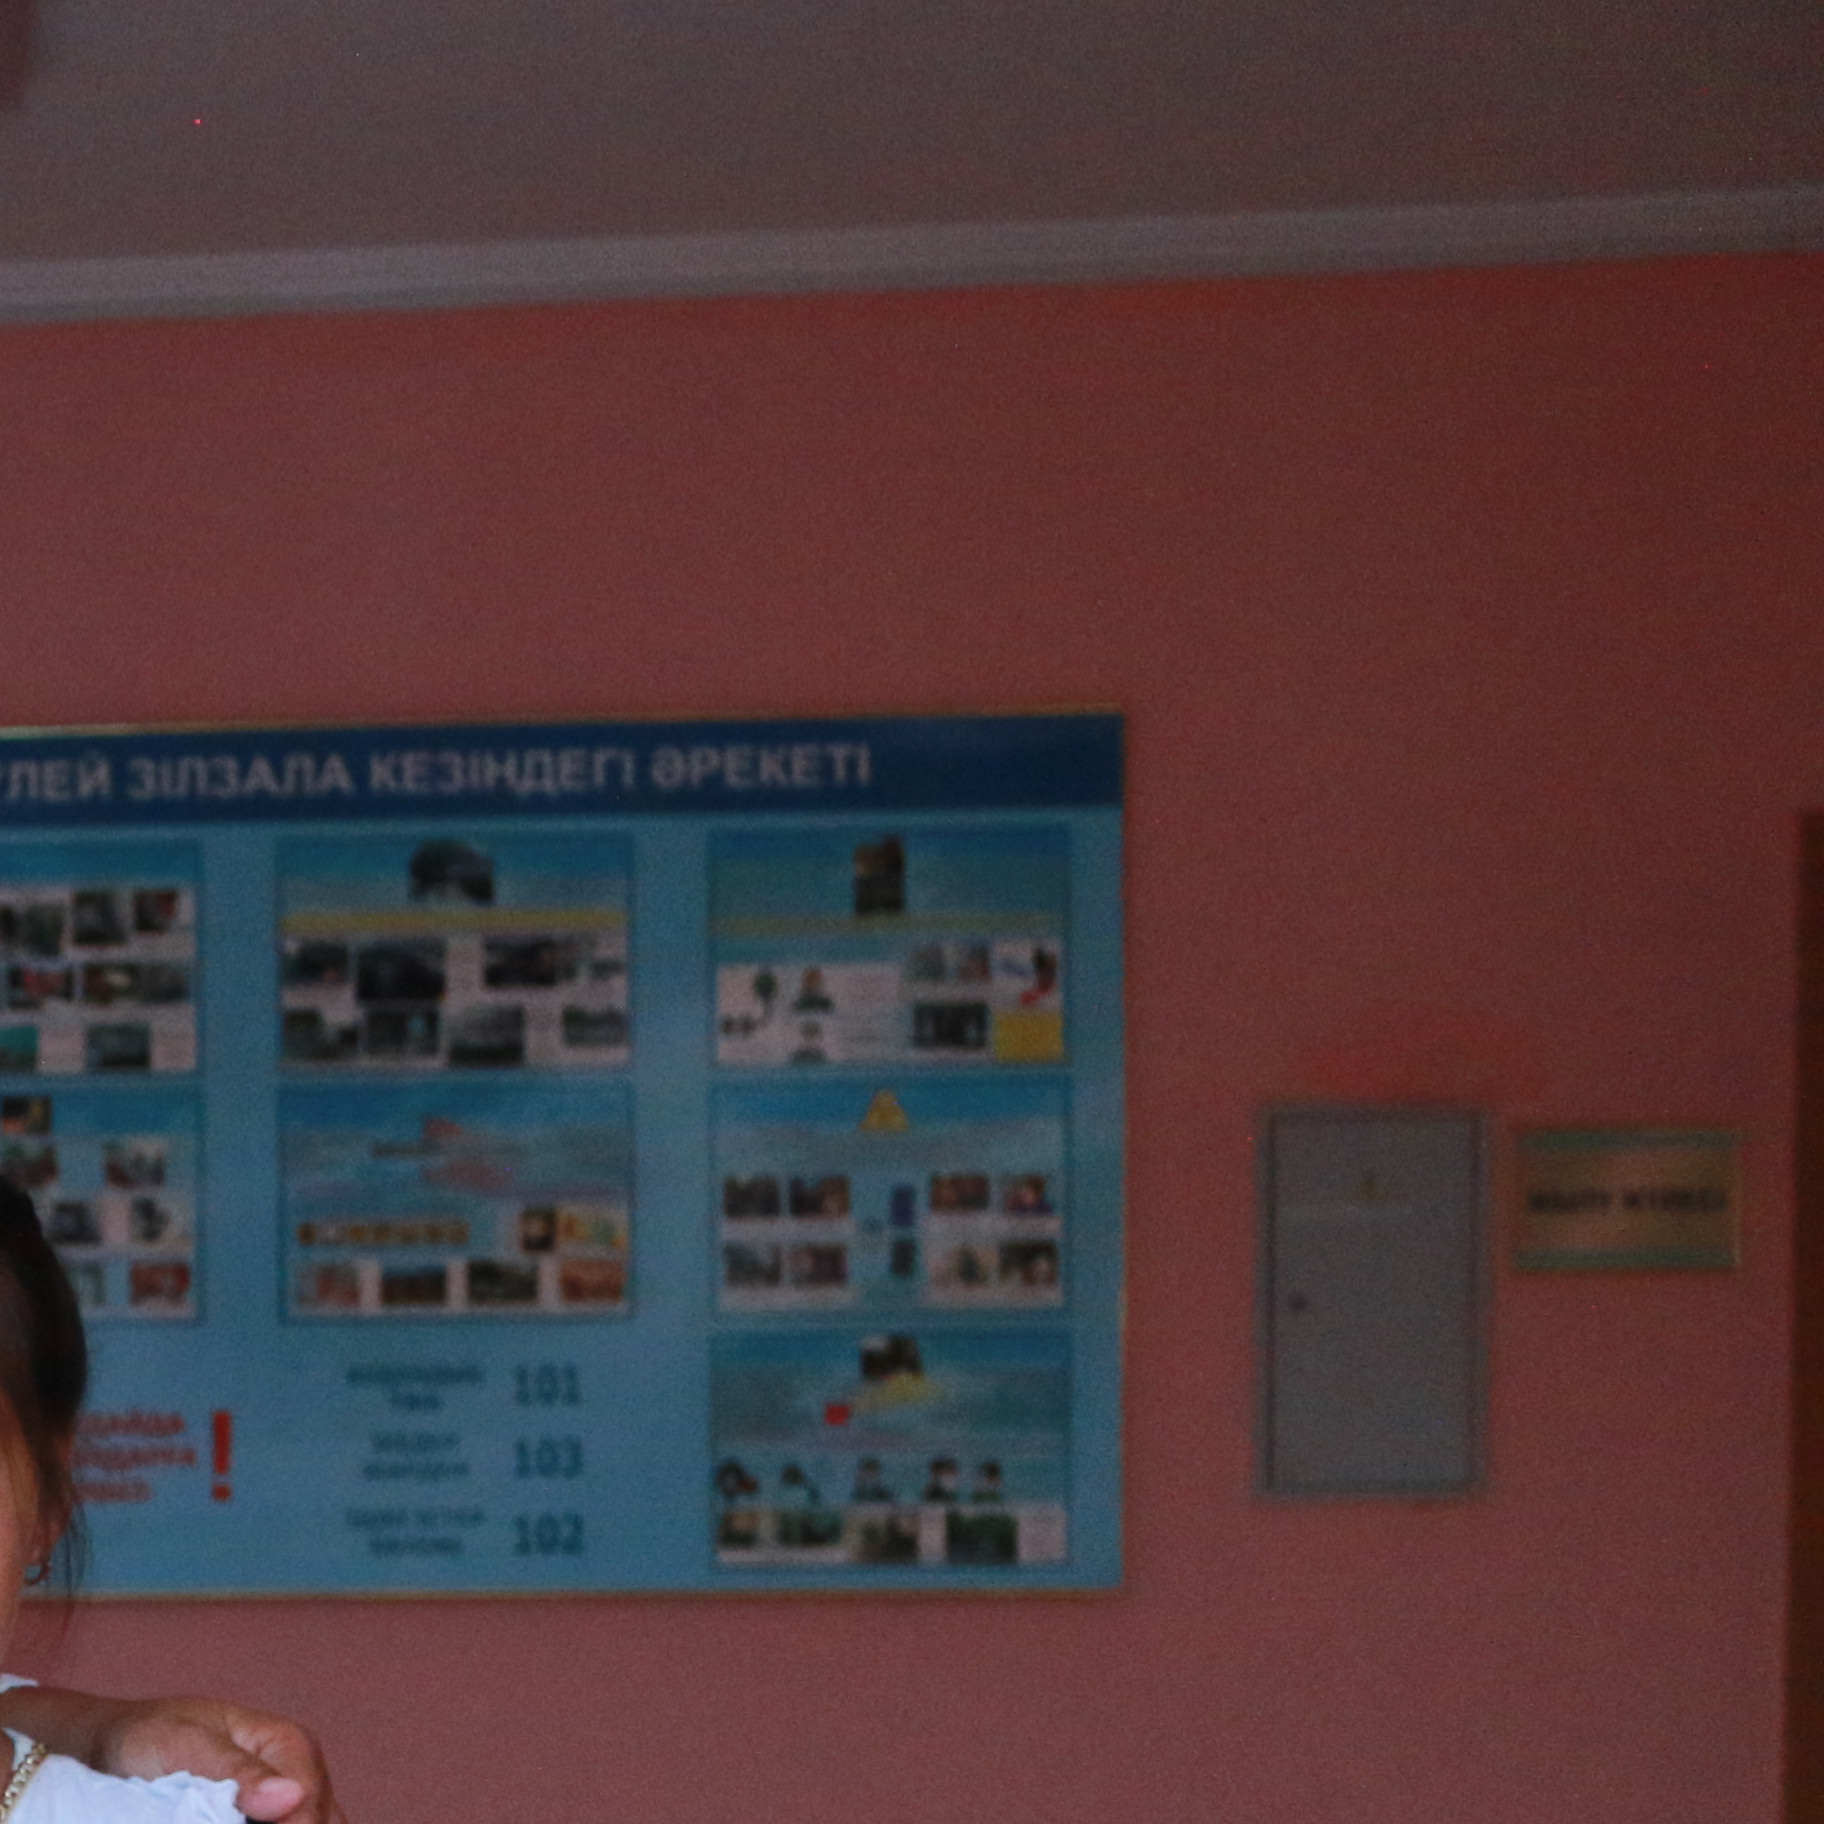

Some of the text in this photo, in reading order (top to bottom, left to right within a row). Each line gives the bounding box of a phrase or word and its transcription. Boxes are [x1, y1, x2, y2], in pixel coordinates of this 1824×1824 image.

[126, 754, 356, 800] ЗІЛЗАЛА
[369, 746, 635, 798] КЕЗІНДЕГІ
[651, 743, 872, 791] ӘРЕКЕТІ
[515, 1363, 582, 1406] 101
[514, 1435, 583, 1478] 103
[514, 1513, 584, 1556] 102
